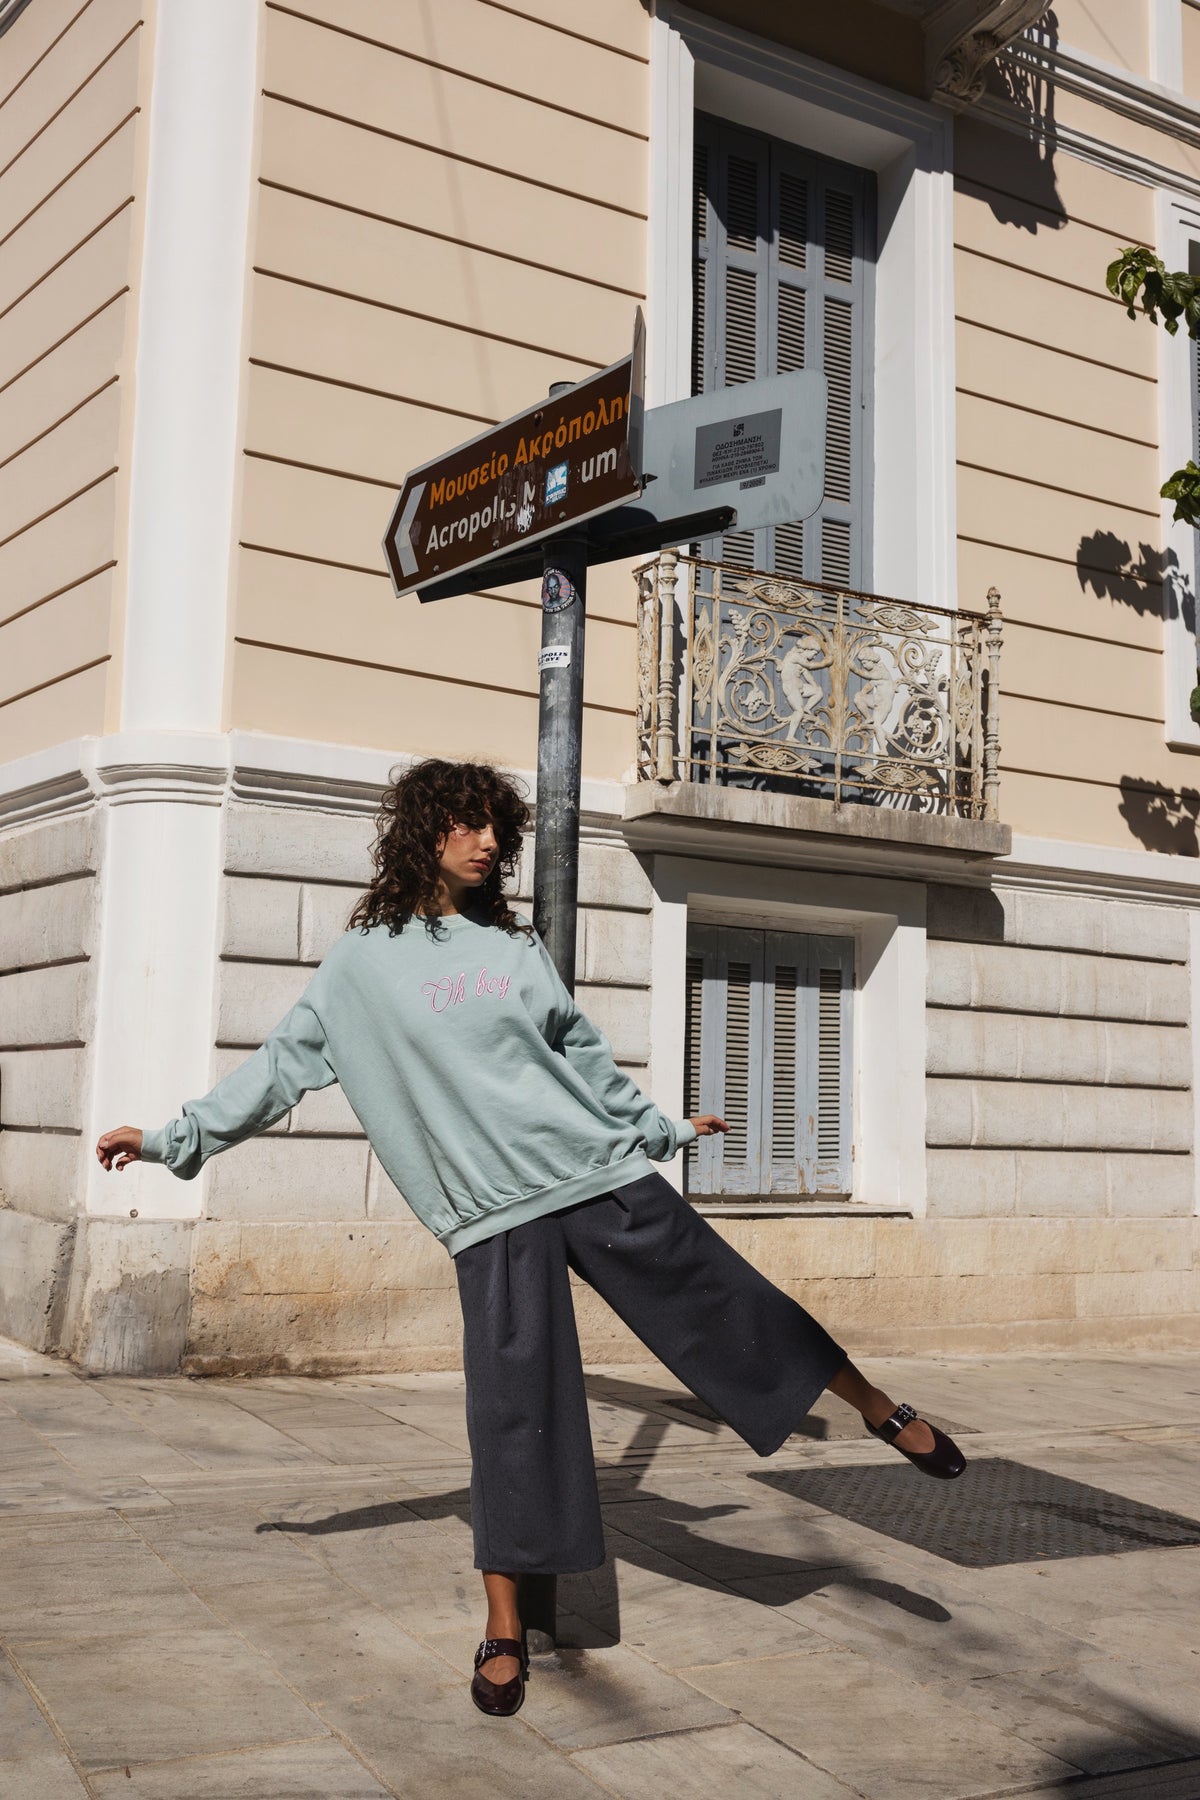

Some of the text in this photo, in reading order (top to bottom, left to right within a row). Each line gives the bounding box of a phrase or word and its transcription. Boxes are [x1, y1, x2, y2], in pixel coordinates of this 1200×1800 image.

[715, 435, 762, 451] ΟΔΟΣΗΜΑΝΣΗ
[429, 451, 509, 510] Μουσείο
[523, 448, 617, 509] Mum
[421, 966, 512, 1013] Oh boy
